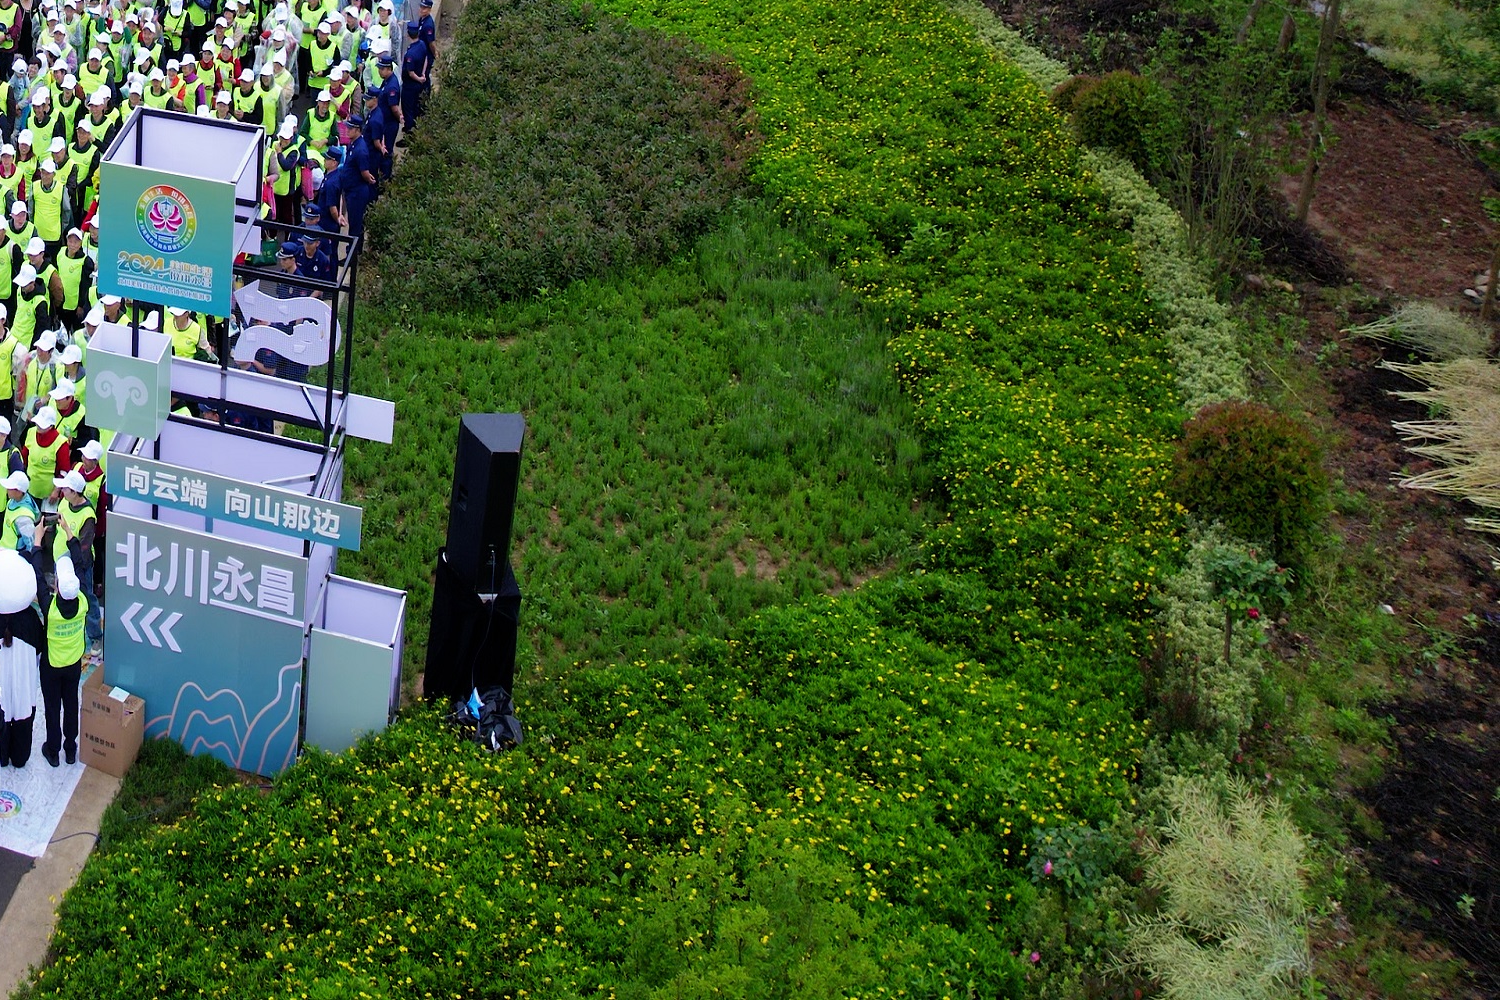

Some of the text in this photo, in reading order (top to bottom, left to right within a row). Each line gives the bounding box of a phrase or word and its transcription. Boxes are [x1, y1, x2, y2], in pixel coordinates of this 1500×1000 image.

[117, 251, 165, 278] 2024
[124, 465, 341, 540] 向云端 向山那边
[114, 531, 296, 616] 北川永昌
